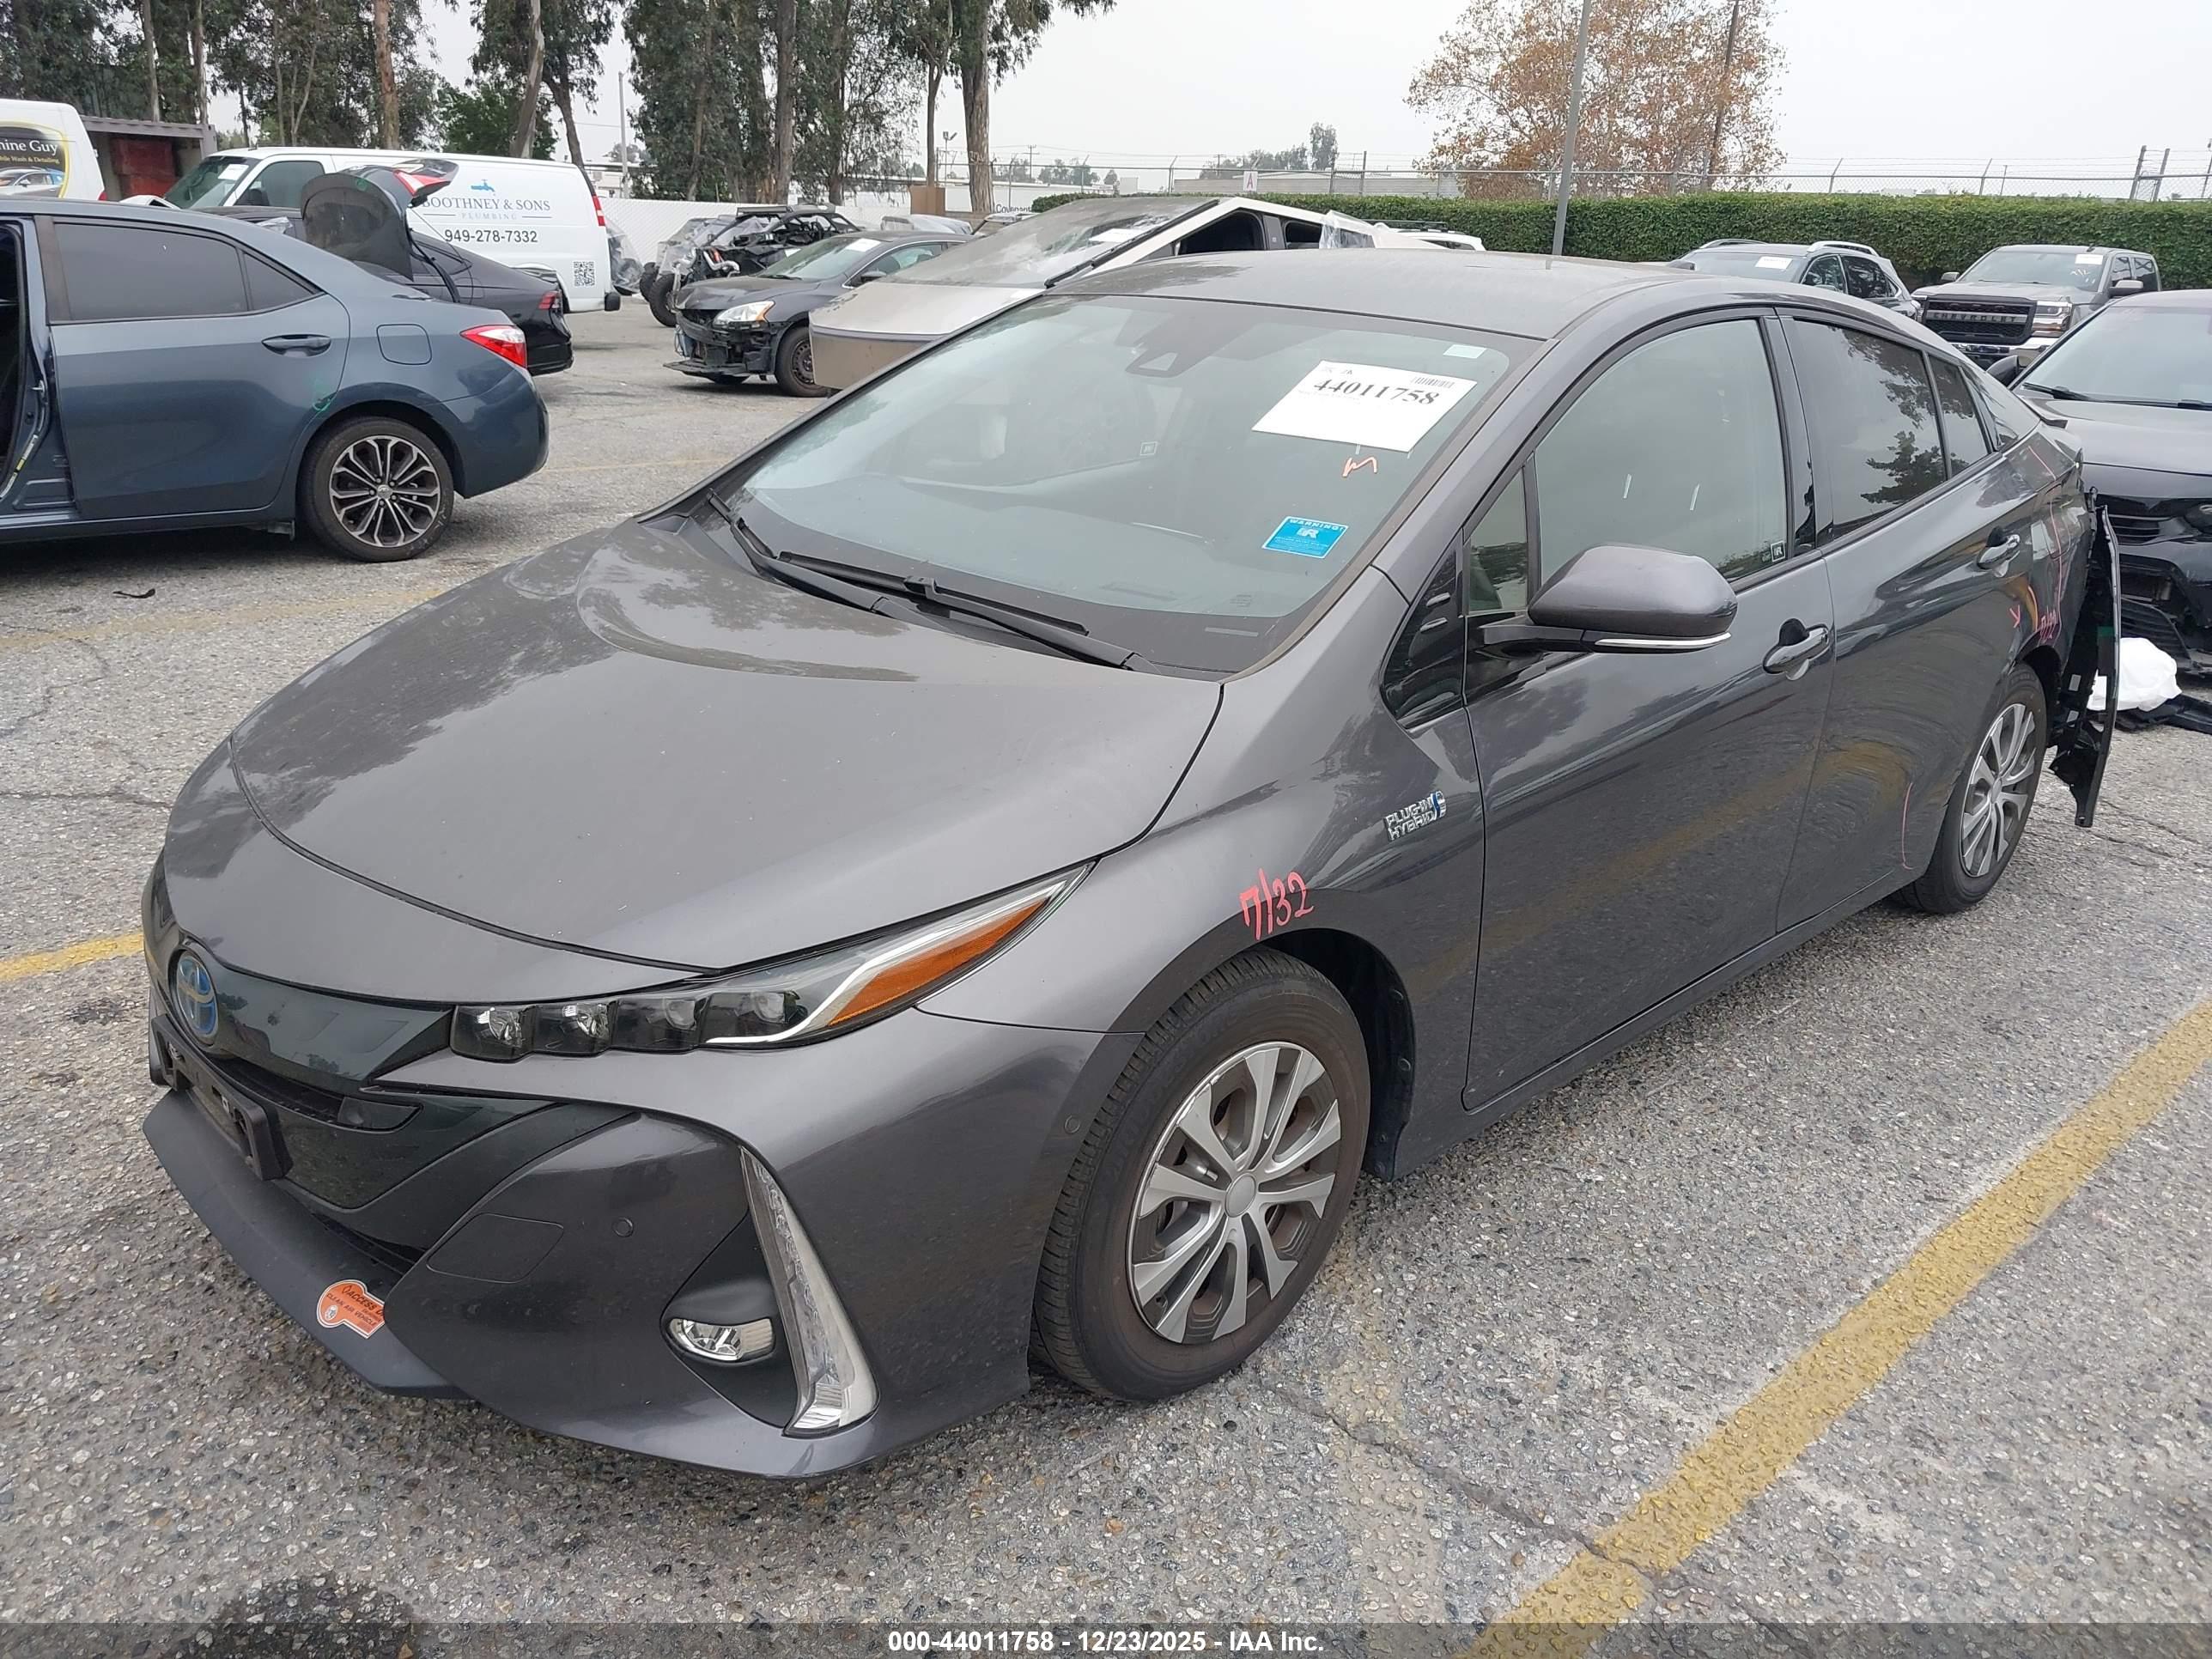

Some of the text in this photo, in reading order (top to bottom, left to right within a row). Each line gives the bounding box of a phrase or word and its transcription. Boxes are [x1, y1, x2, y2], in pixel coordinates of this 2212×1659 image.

[29, 140, 58, 155] Guy
[1246, 172, 1254, 189] A
[503, 199, 514, 210] &
[516, 199, 550, 211] SONS
[995, 204, 1032, 214] Covenant
[461, 212, 518, 221] PLUMBING
[444, 229, 538, 243] 949-278-7332
[1934, 313, 2017, 323] CHEVROLET
[1314, 379, 1440, 404] 44011758
[1385, 795, 1433, 827] PLUG-IN
[1388, 811, 1436, 841] HYBRID
[346, 1290, 378, 1311] ACCESS
